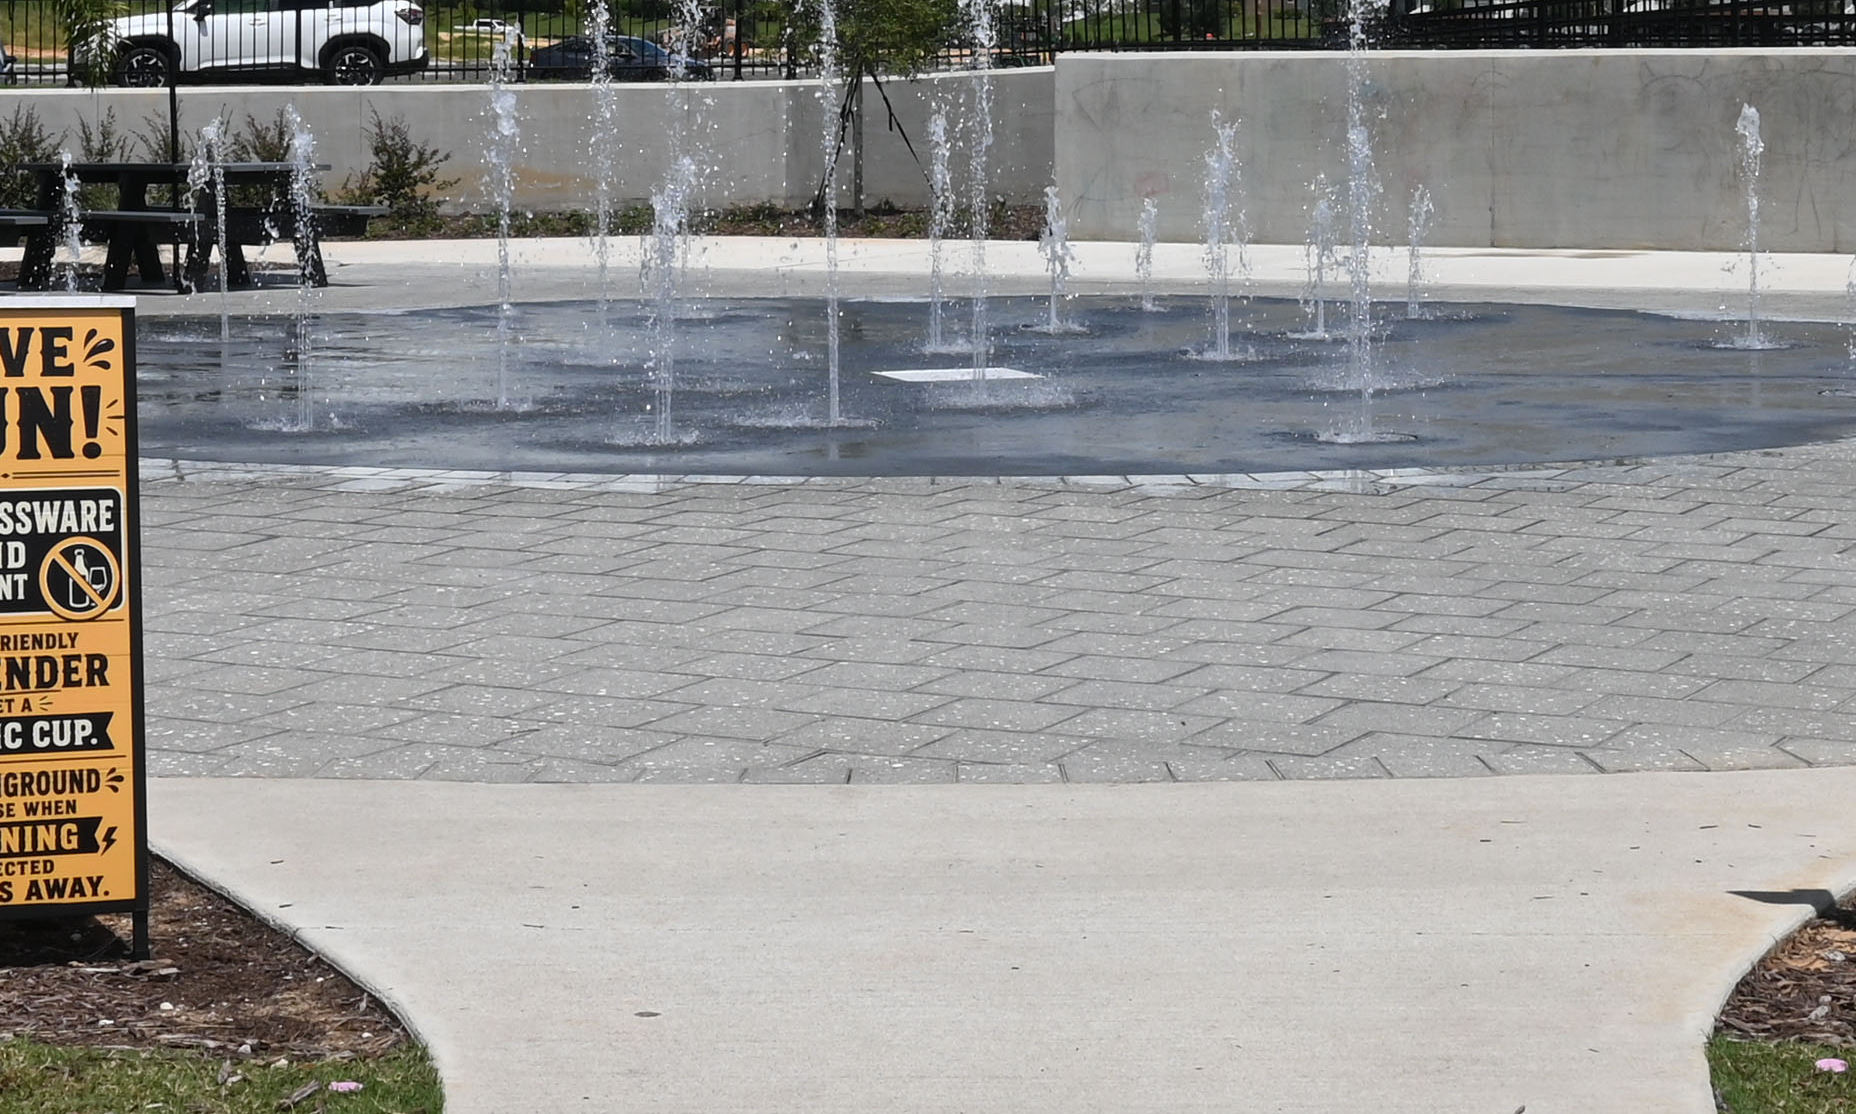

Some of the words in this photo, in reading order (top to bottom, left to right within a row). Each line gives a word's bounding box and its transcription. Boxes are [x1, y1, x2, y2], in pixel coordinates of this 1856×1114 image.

[20, 697, 33, 712] A
[32, 719, 98, 749] CUP.
[23, 799, 77, 817] WHEN
[25, 875, 110, 901] AWAY.
